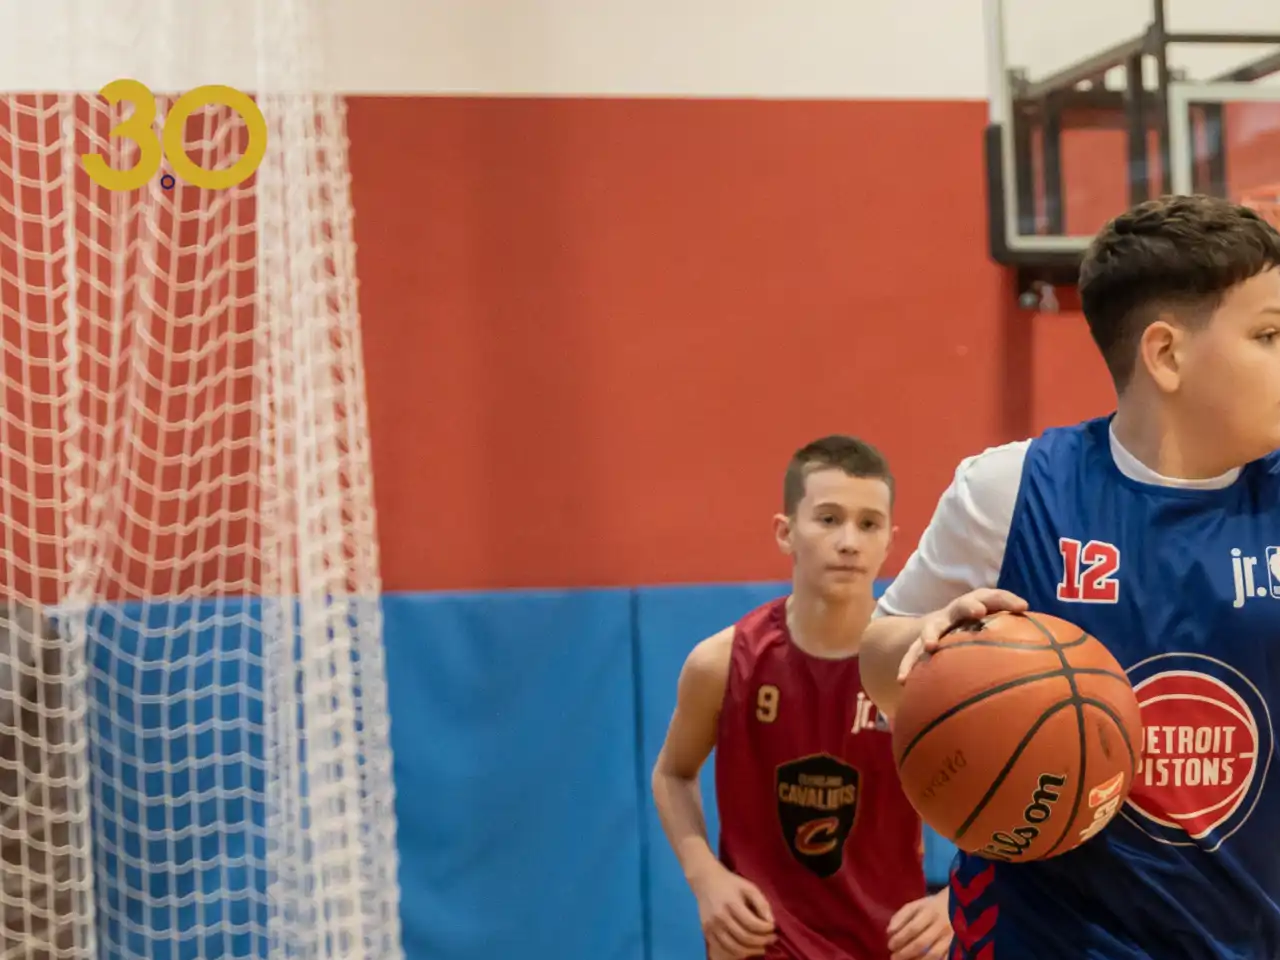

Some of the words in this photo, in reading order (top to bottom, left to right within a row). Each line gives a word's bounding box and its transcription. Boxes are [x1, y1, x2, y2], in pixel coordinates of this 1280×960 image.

[1057, 537, 1120, 604] 12
[1230, 547, 1267, 608] jr.
[756, 684, 780, 723] 9
[1140, 725, 1237, 754] ETROIT
